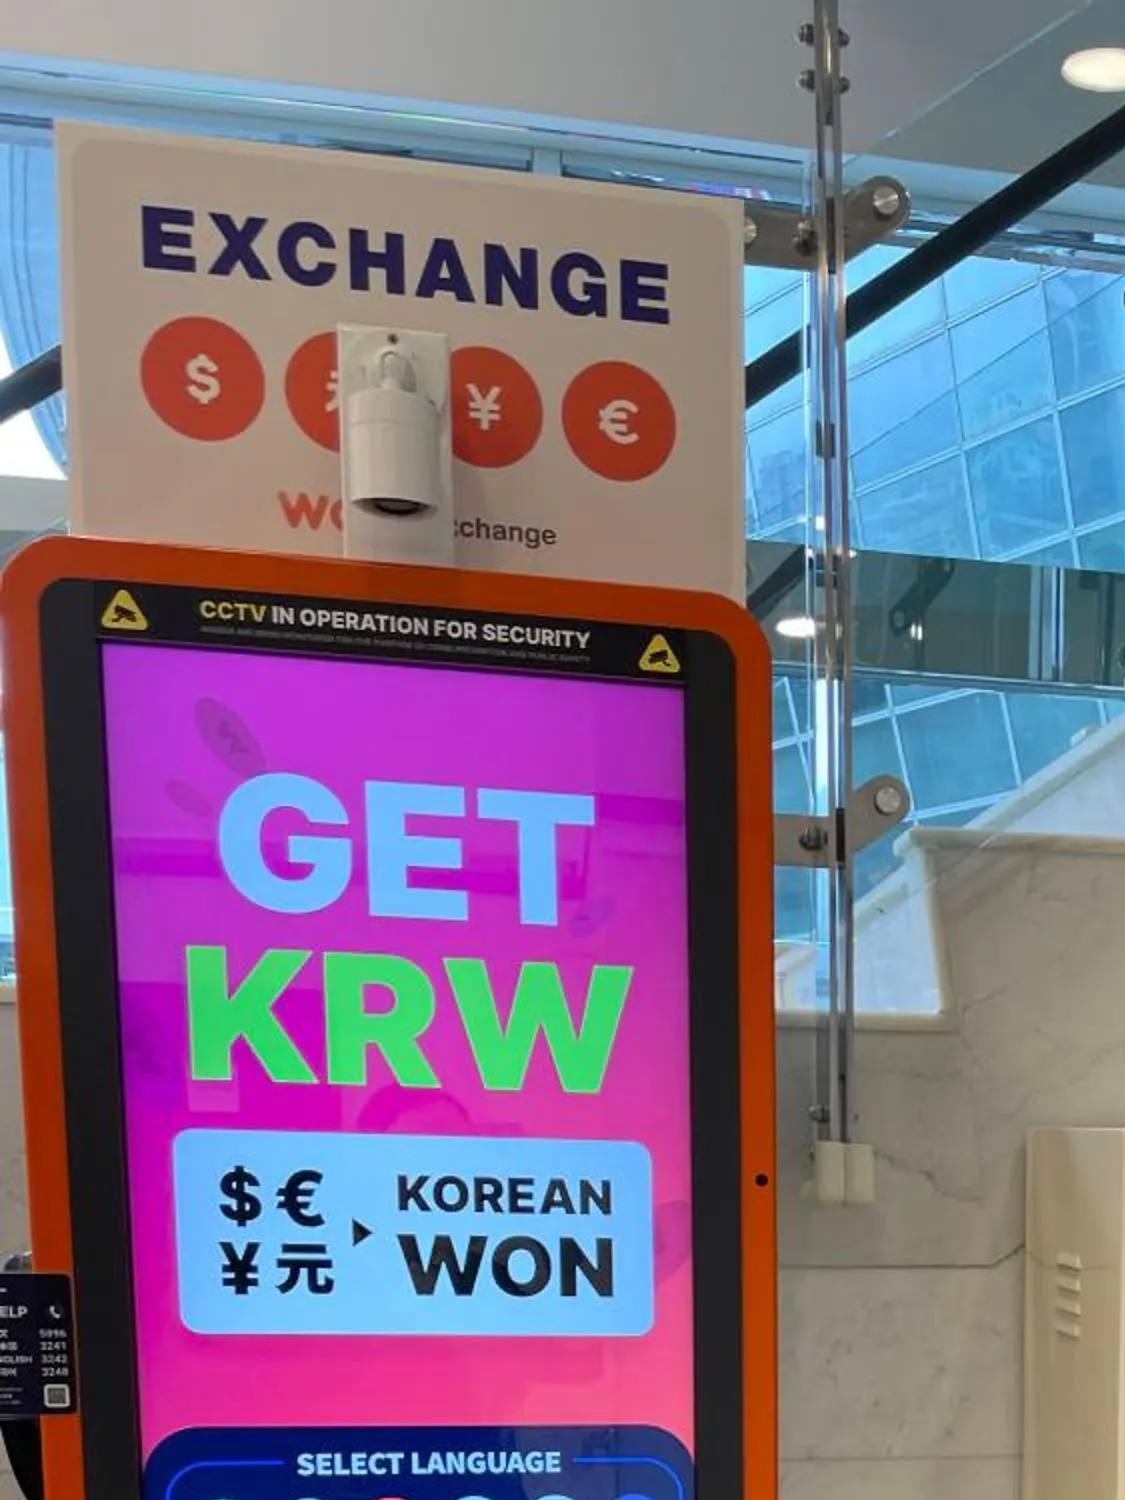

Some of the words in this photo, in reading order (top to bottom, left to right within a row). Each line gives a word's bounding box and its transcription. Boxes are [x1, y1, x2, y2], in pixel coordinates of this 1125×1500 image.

[141, 205, 670, 325] EXCHANGE
[200, 600, 266, 623] CCTV
[272, 606, 295, 624] IN
[299, 608, 429, 636] OPERATION
[434, 619, 477, 640] FOR
[482, 624, 591, 650] SECURITY
[219, 772, 595, 926] GET
[186, 945, 634, 1093] KRW
[219, 1165, 262, 1227] $
[276, 1169, 325, 1227] €
[397, 1174, 612, 1216] KOREAN
[276, 1243, 335, 1295] 元
[397, 1234, 614, 1298] WON
[297, 1453, 404, 1476] SELECT
[411, 1451, 561, 1475] LANGUAGE
